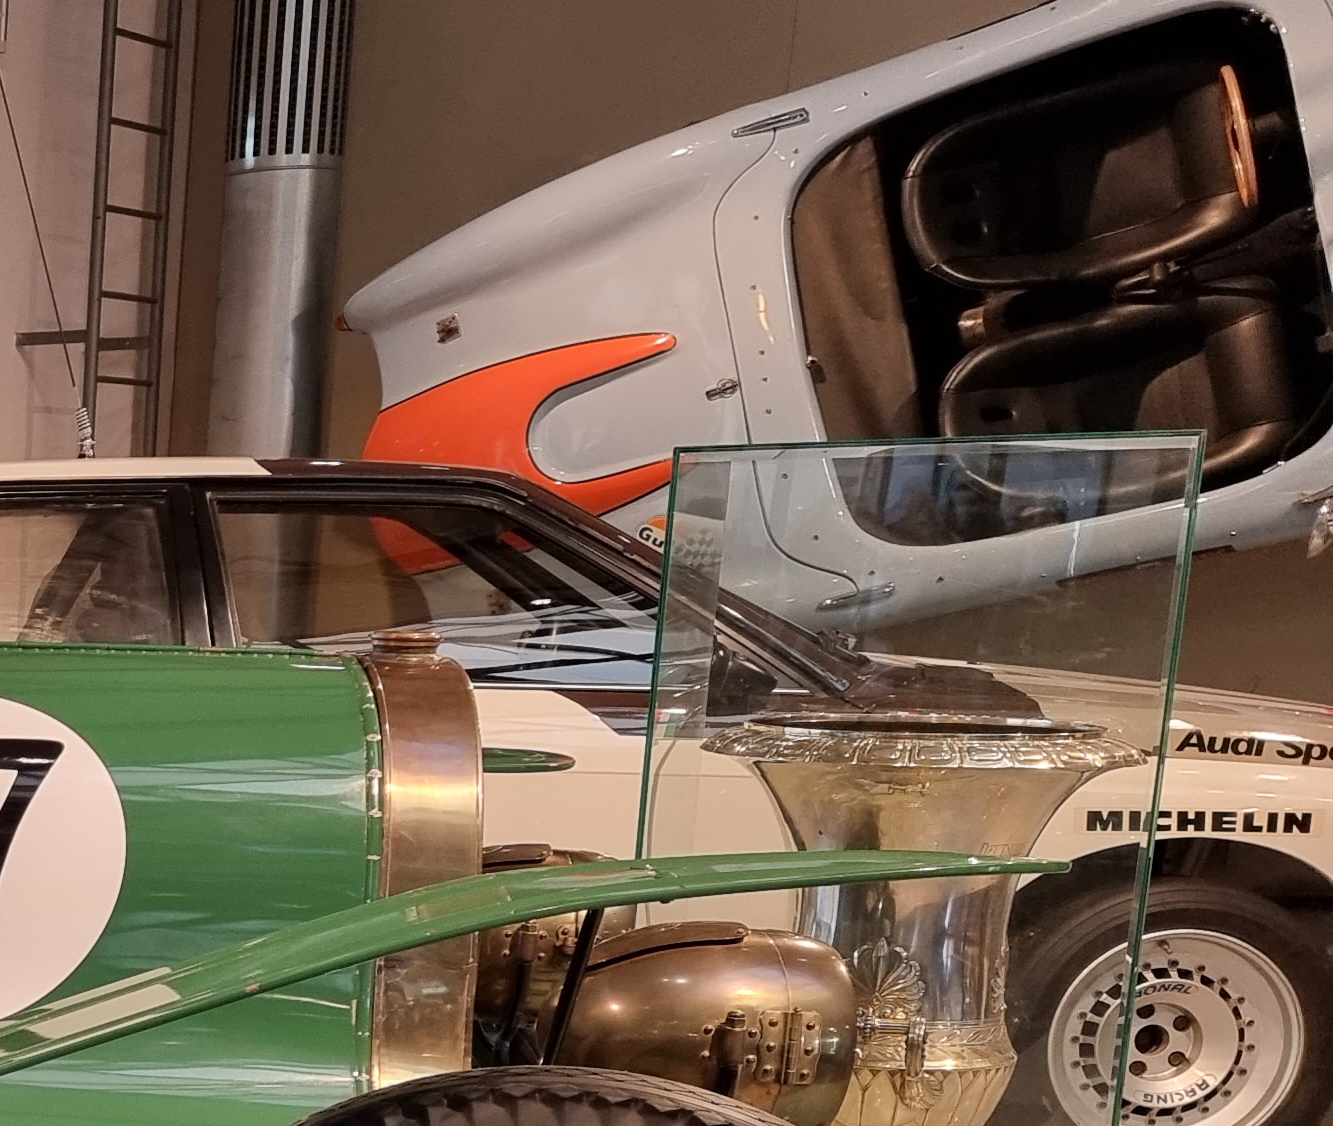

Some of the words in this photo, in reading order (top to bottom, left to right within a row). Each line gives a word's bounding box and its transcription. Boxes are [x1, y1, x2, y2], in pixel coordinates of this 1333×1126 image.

[638, 526, 665, 548] Gu
[1175, 730, 1265, 756] Audi
[1276, 740, 1333, 765] Sp
[1086, 810, 1313, 834] MICHELIN
[1142, 1078, 1210, 1104] RACING
